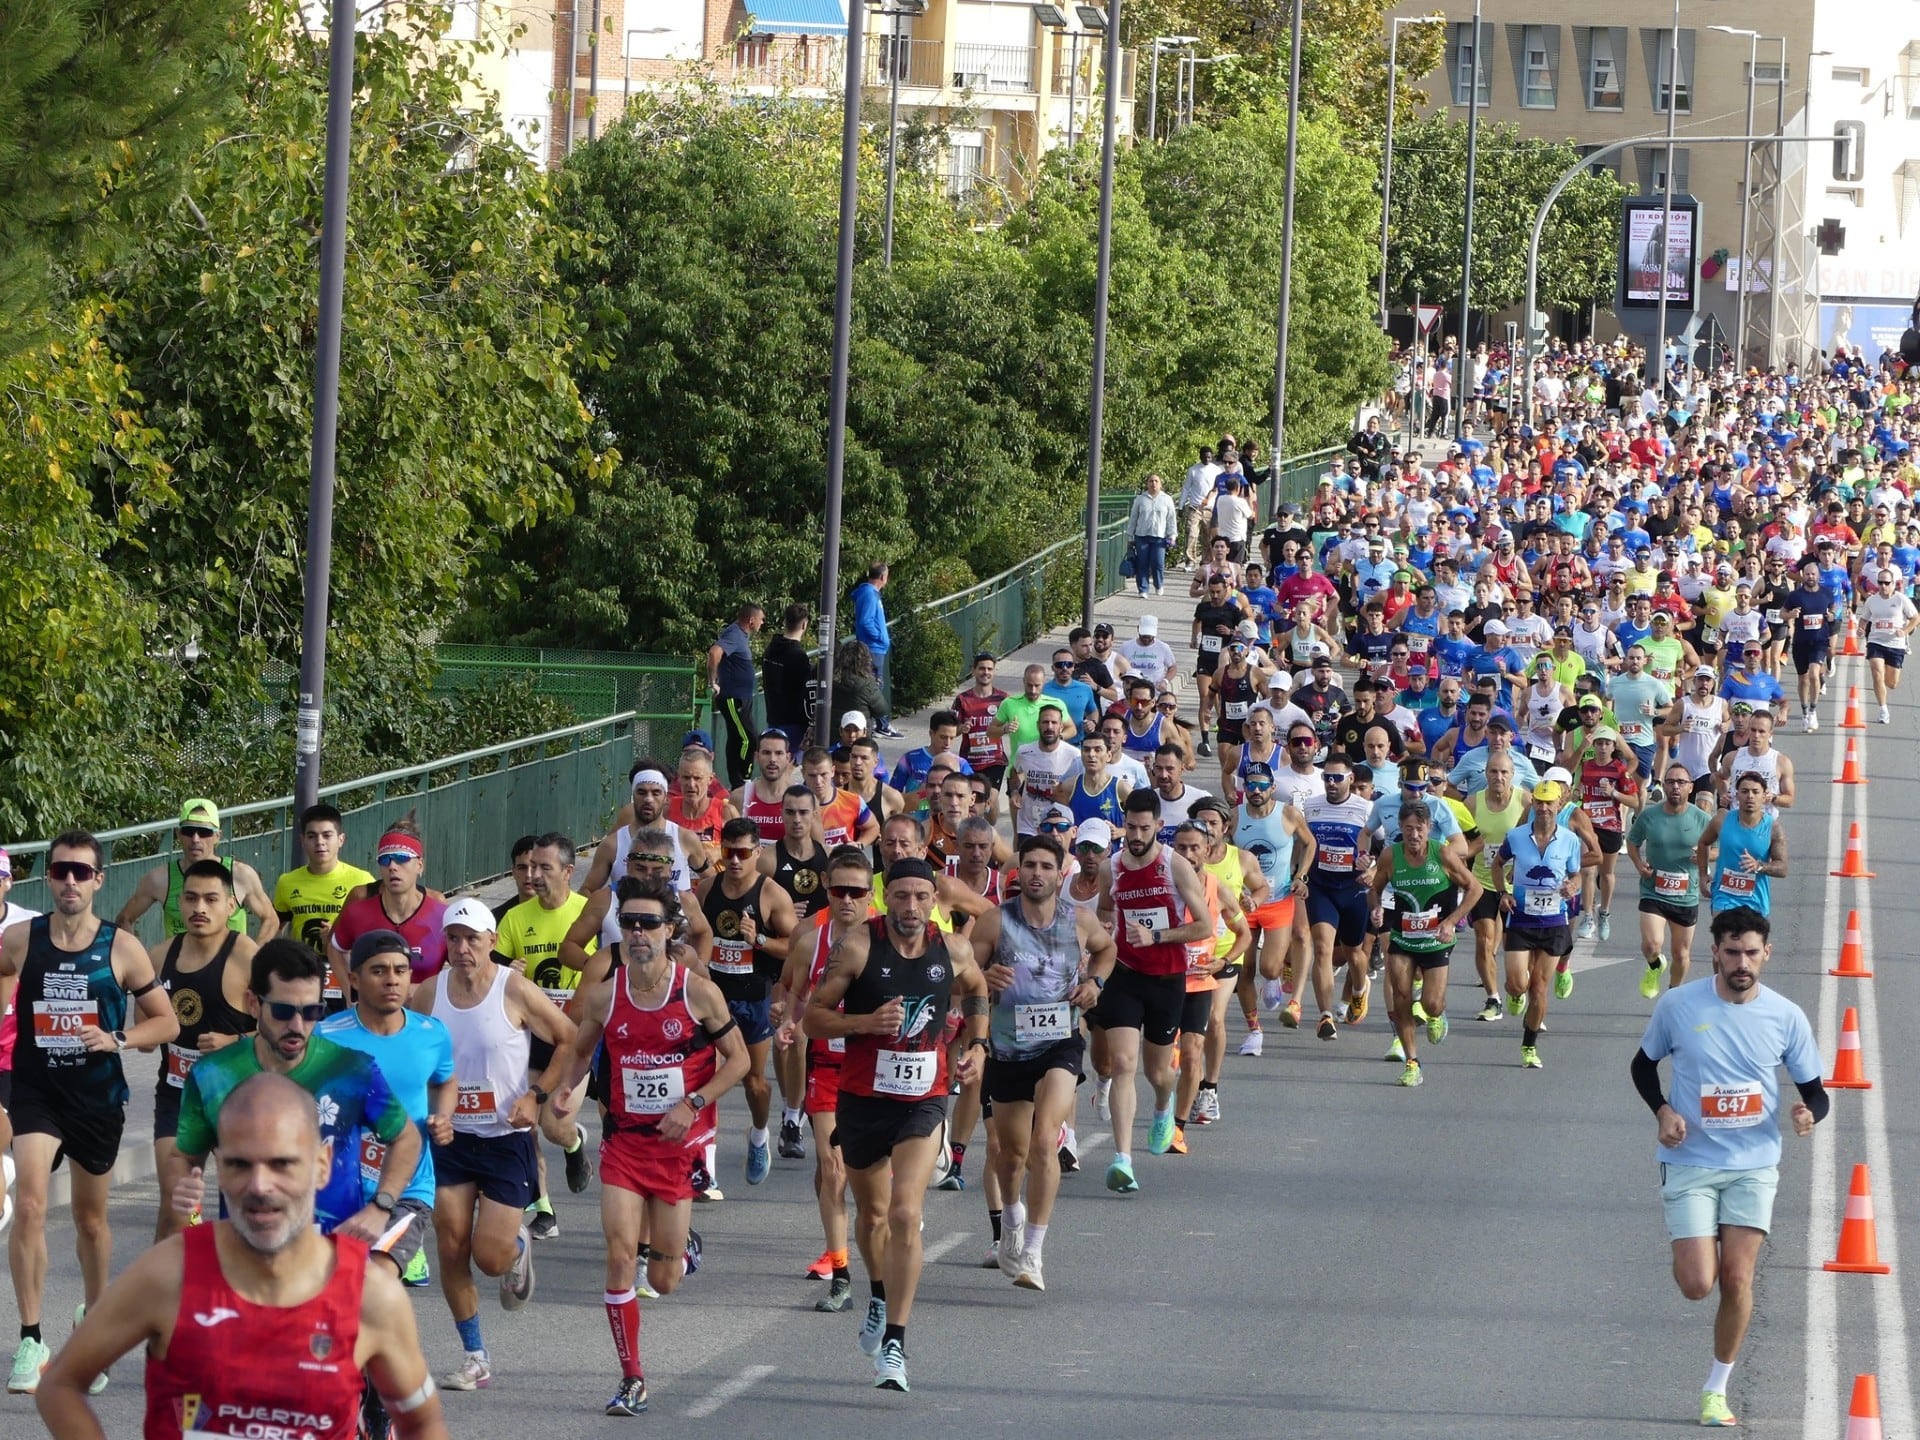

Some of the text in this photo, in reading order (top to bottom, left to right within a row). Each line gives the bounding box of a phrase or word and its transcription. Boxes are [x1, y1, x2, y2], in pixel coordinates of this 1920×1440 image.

[1821, 268, 1868, 293] SAN
[1326, 853, 1344, 863] 582
[1412, 878, 1440, 886] CHARRA
[1663, 879, 1680, 888] 799
[1728, 877, 1746, 888] 619
[1116, 886, 1168, 900] PUERTAS LORCA
[1534, 897, 1553, 907] 212
[1410, 920, 1430, 930] 867
[524, 942, 558, 955] TRIATLÓN
[719, 950, 742, 962] 589
[43, 988, 88, 1000] SWIM
[51, 1005, 84, 1013] ANDAMUR
[49, 1015, 83, 1031] 709
[1029, 1013, 1057, 1028] 124
[899, 1055, 926, 1063] ANDAMUR
[640, 1073, 669, 1081] ANDAMUR
[894, 1064, 922, 1080] 151
[636, 1083, 668, 1098] 226
[878, 1082, 913, 1091] AVANZA
[459, 1094, 481, 1110] 43
[629, 1102, 661, 1110] AVANZA
[1717, 1096, 1748, 1112] 647
[218, 1403, 333, 1430] PUERTAS
